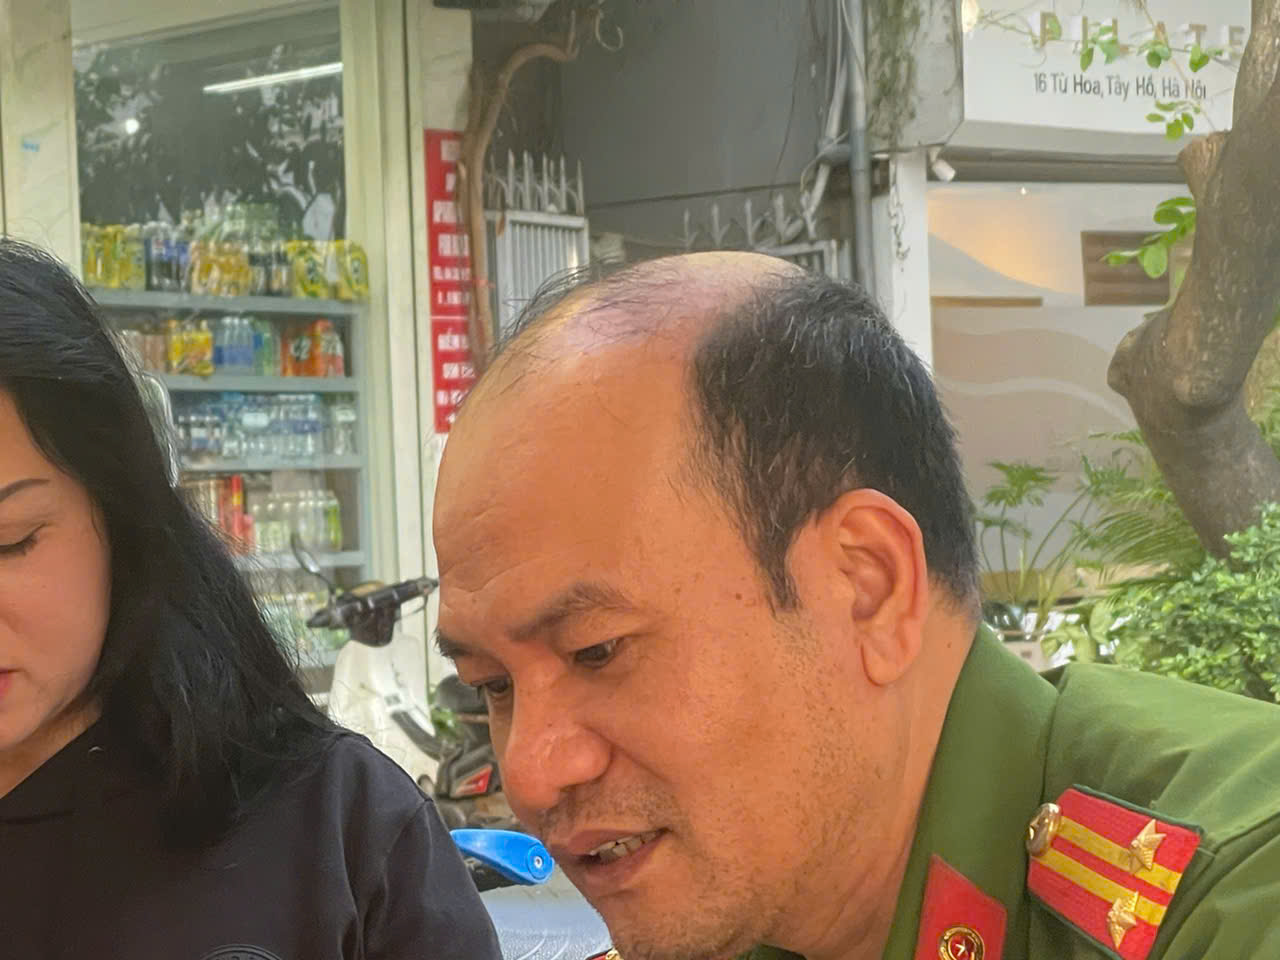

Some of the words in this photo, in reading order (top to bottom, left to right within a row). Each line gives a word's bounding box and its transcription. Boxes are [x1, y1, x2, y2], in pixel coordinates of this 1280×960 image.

[1034, 72, 1047, 93] 16
[1073, 73, 1104, 99] Hoa,
[1106, 74, 1130, 102] Tây
[1162, 76, 1180, 97] Hà
